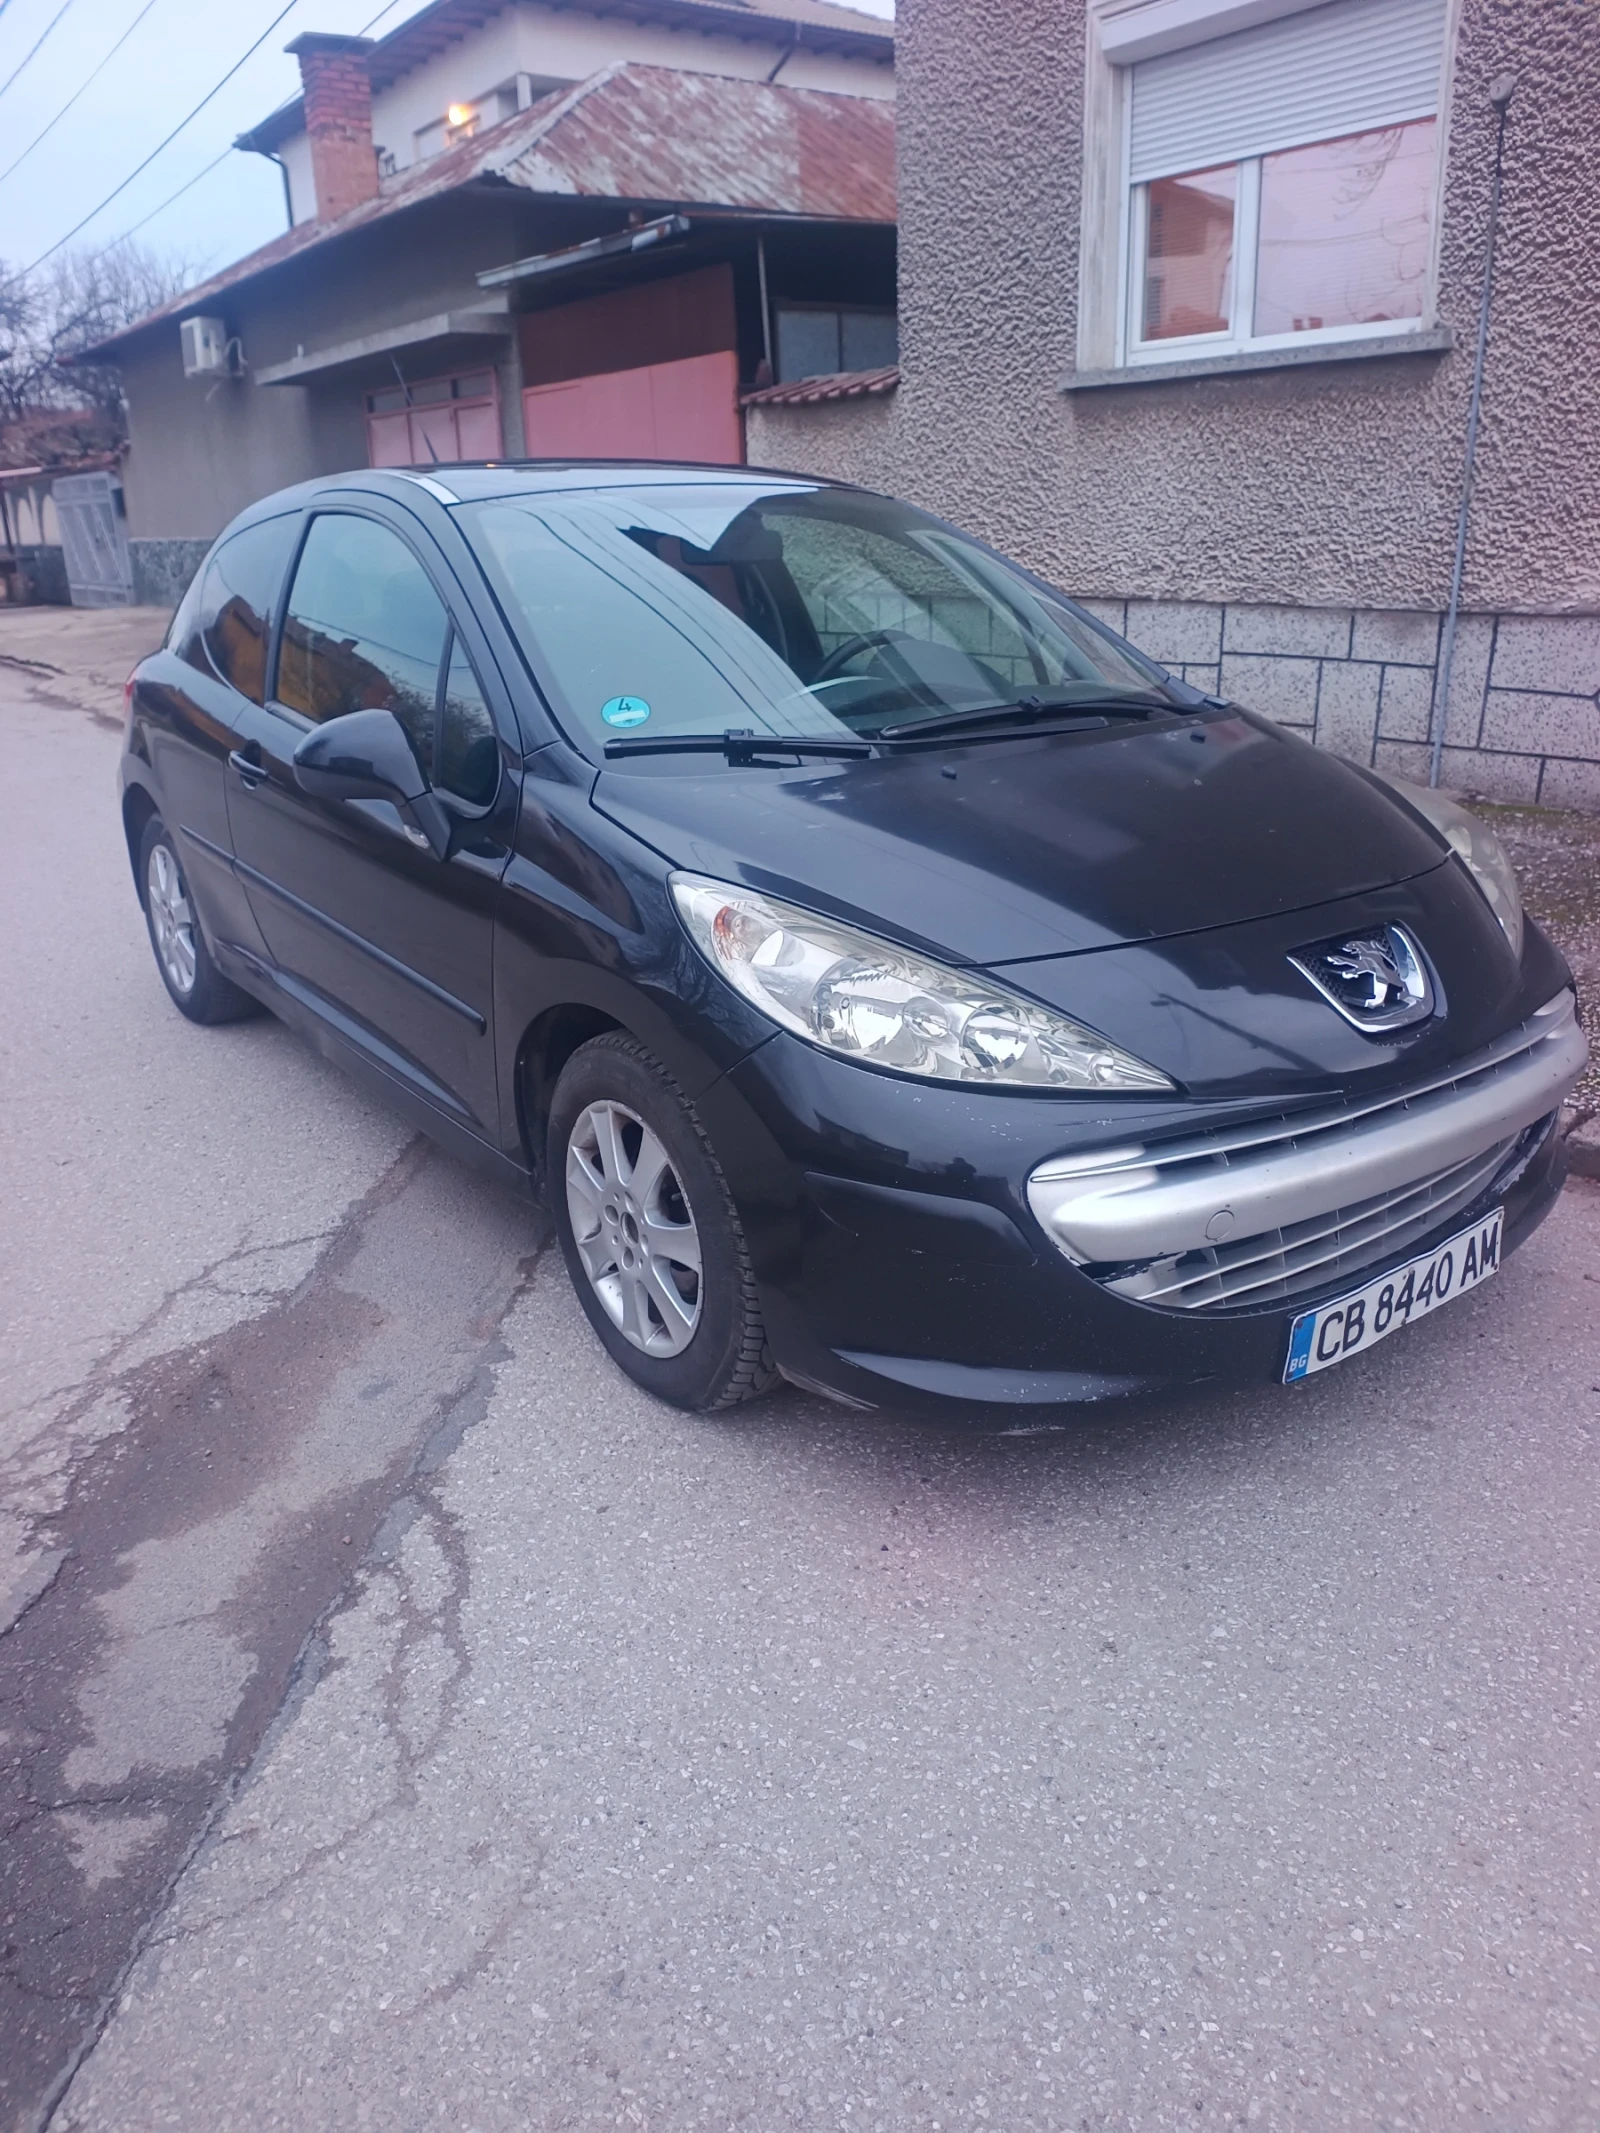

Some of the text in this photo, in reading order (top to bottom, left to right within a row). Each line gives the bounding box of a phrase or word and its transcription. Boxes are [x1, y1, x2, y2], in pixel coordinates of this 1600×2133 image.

[618, 698, 632, 711] 4
[1316, 1221, 1499, 1362] CB 8440 AM
[1289, 1354, 1307, 1373] BG
